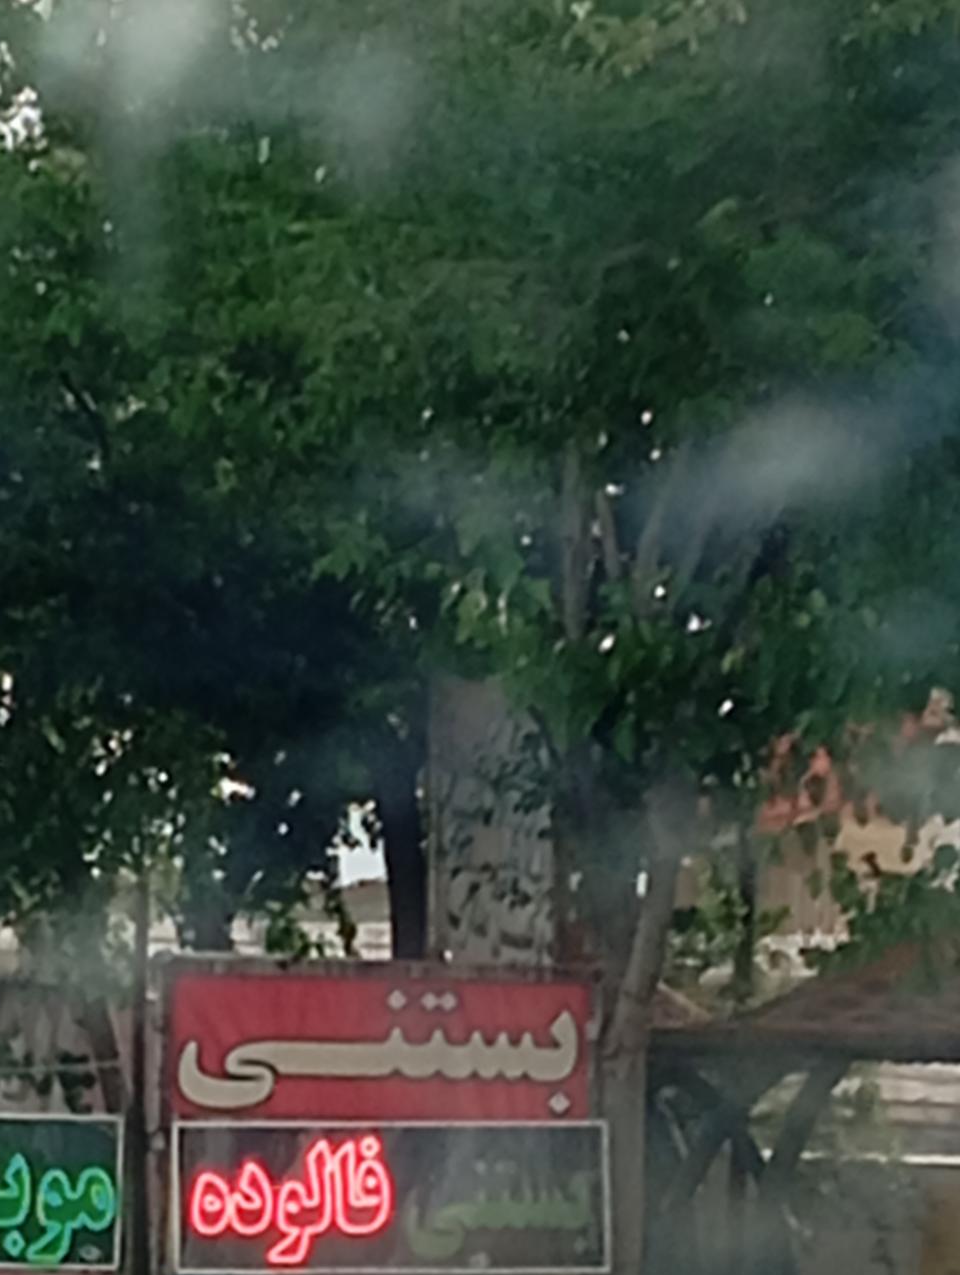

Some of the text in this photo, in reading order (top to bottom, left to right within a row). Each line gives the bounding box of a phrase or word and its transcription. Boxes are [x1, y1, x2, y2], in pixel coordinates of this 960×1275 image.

[178, 989, 578, 1113] بستنی
[190, 1136, 589, 1266] بستنی فالوده
